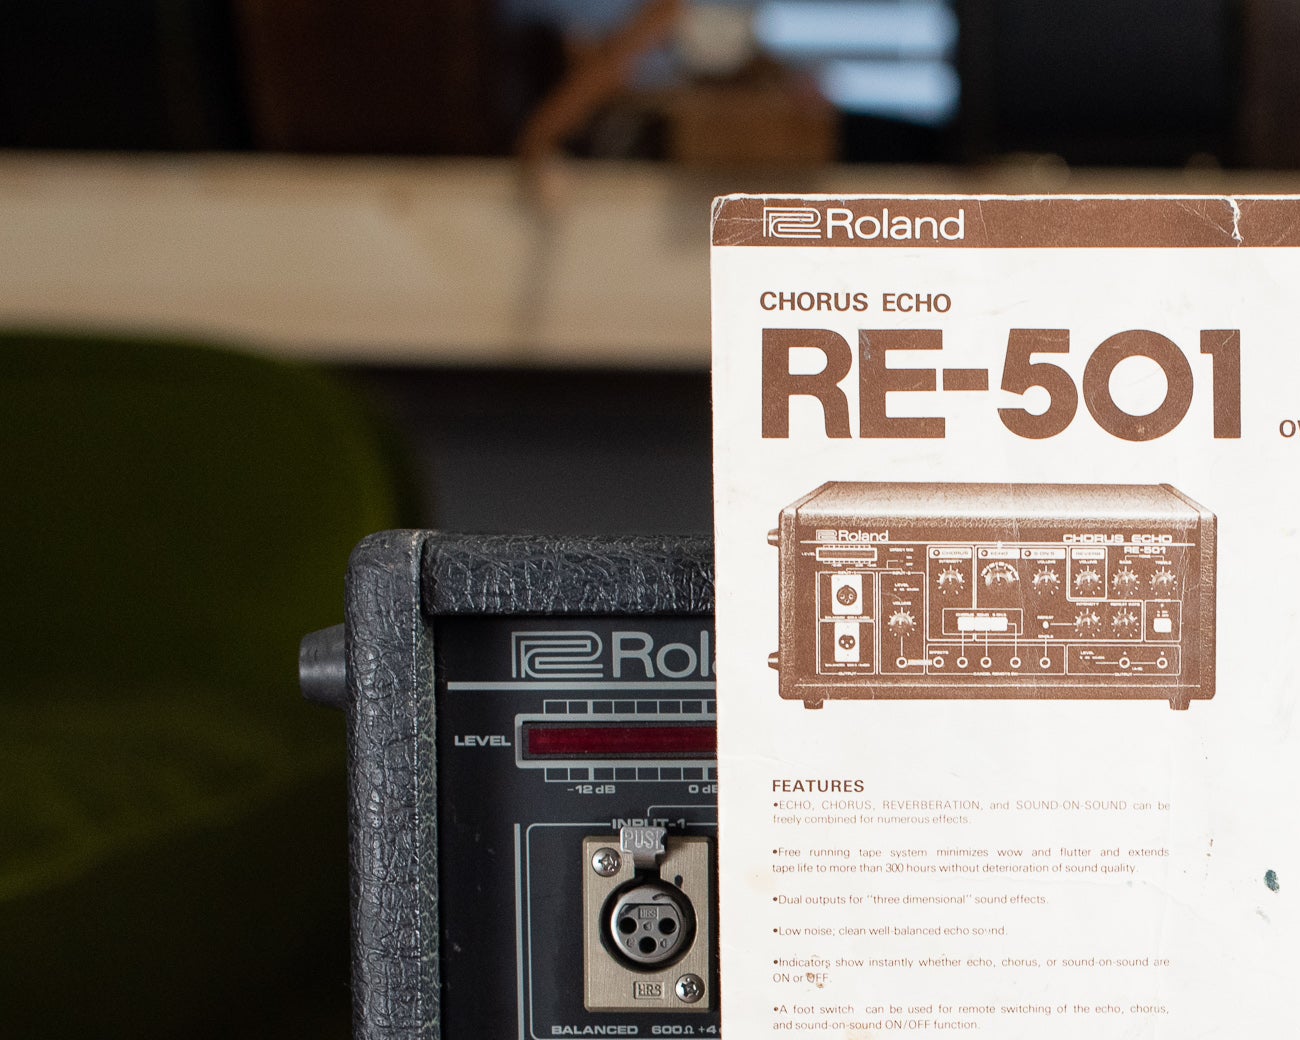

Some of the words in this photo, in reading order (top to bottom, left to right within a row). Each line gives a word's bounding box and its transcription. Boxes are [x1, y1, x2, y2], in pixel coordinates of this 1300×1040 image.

[824, 202, 965, 243] Roland
[759, 291, 869, 312] CHORUS
[882, 292, 952, 314] ECHO
[761, 327, 1242, 443] RE-501
[838, 529, 889, 542] Roland
[1061, 533, 1126, 544] CHORUS
[1129, 533, 1173, 544] ECHO
[1123, 545, 1167, 556] RE-501
[611, 630, 717, 679] Rol
[454, 735, 512, 747] LEVEL
[567, 784, 593, 795] -12
[595, 784, 616, 794] dB
[688, 784, 699, 794] 0
[771, 779, 865, 793] FEATURES
[882, 799, 984, 811] REVERBERATION,
[989, 801, 1010, 811] and
[1132, 802, 1152, 811] can
[1157, 801, 1171, 811] be
[772, 813, 802, 827] freely
[804, 813, 857, 825] combined
[859, 814, 874, 825] for
[877, 816, 931, 824] numerous
[778, 846, 801, 858] Free
[809, 848, 851, 860] running
[858, 848, 882, 859] tape
[889, 848, 928, 859] system
[936, 847, 989, 857] minimizes
[996, 848, 1024, 858] wow
[1031, 847, 1052, 858] and
[1059, 847, 1092, 857] flutter
[1099, 847, 1120, 857] and
[1127, 847, 1170, 857] extends
[771, 862, 796, 876] tape
[796, 862, 814, 873] life
[815, 862, 828, 873] to
[829, 864, 857, 873] more
[858, 862, 884, 873] than
[885, 862, 905, 873] 300
[905, 862, 937, 873] hours
[938, 862, 980, 873] without
[981, 862, 1049, 873] deterioration
[1050, 862, 1063, 873] of
[1064, 862, 1098, 873] sound
[1100, 862, 1139, 876] quality.
[778, 894, 803, 905] Dual
[804, 895, 847, 907] outputs
[848, 894, 864, 905] for
[974, 894, 1008, 905] sound
[1009, 894, 1049, 905] effects.
[778, 925, 802, 937] Low
[838, 925, 867, 936] clean
[943, 925, 970, 936] echo
[779, 956, 831, 968] Indicators
[835, 956, 865, 969] show
[868, 957, 914, 969] instantly
[918, 956, 962, 968] whether
[966, 956, 996, 969] echo,
[1001, 956, 1041, 968] chorus,
[1046, 959, 1057, 967] or
[1061, 956, 1149, 969] sound-on-sound
[1153, 959, 1170, 967] are
[772, 972, 791, 984] ON
[792, 974, 805, 984] or
[778, 1004, 789, 1015] A
[792, 1003, 815, 1016] foot
[819, 1004, 855, 1015] switch
[865, 1006, 885, 1015] can
[889, 1003, 903, 1015] be
[907, 1003, 933, 1015] used
[938, 1003, 953, 1014] for
[958, 1004, 996, 1014] remote
[1000, 1003, 1052, 1017] switching
[1056, 1003, 1068, 1014] of
[1073, 1003, 1091, 1014] the
[1094, 1003, 1125, 1015] echo,
[1129, 1003, 1169, 1015] chorus,
[551, 1025, 639, 1035] BALANCED
[772, 1019, 793, 1030] and
[795, 1019, 883, 1030] sound-on-sound
[884, 1019, 932, 1030] ON/OFF
[933, 1019, 980, 1030] function.
